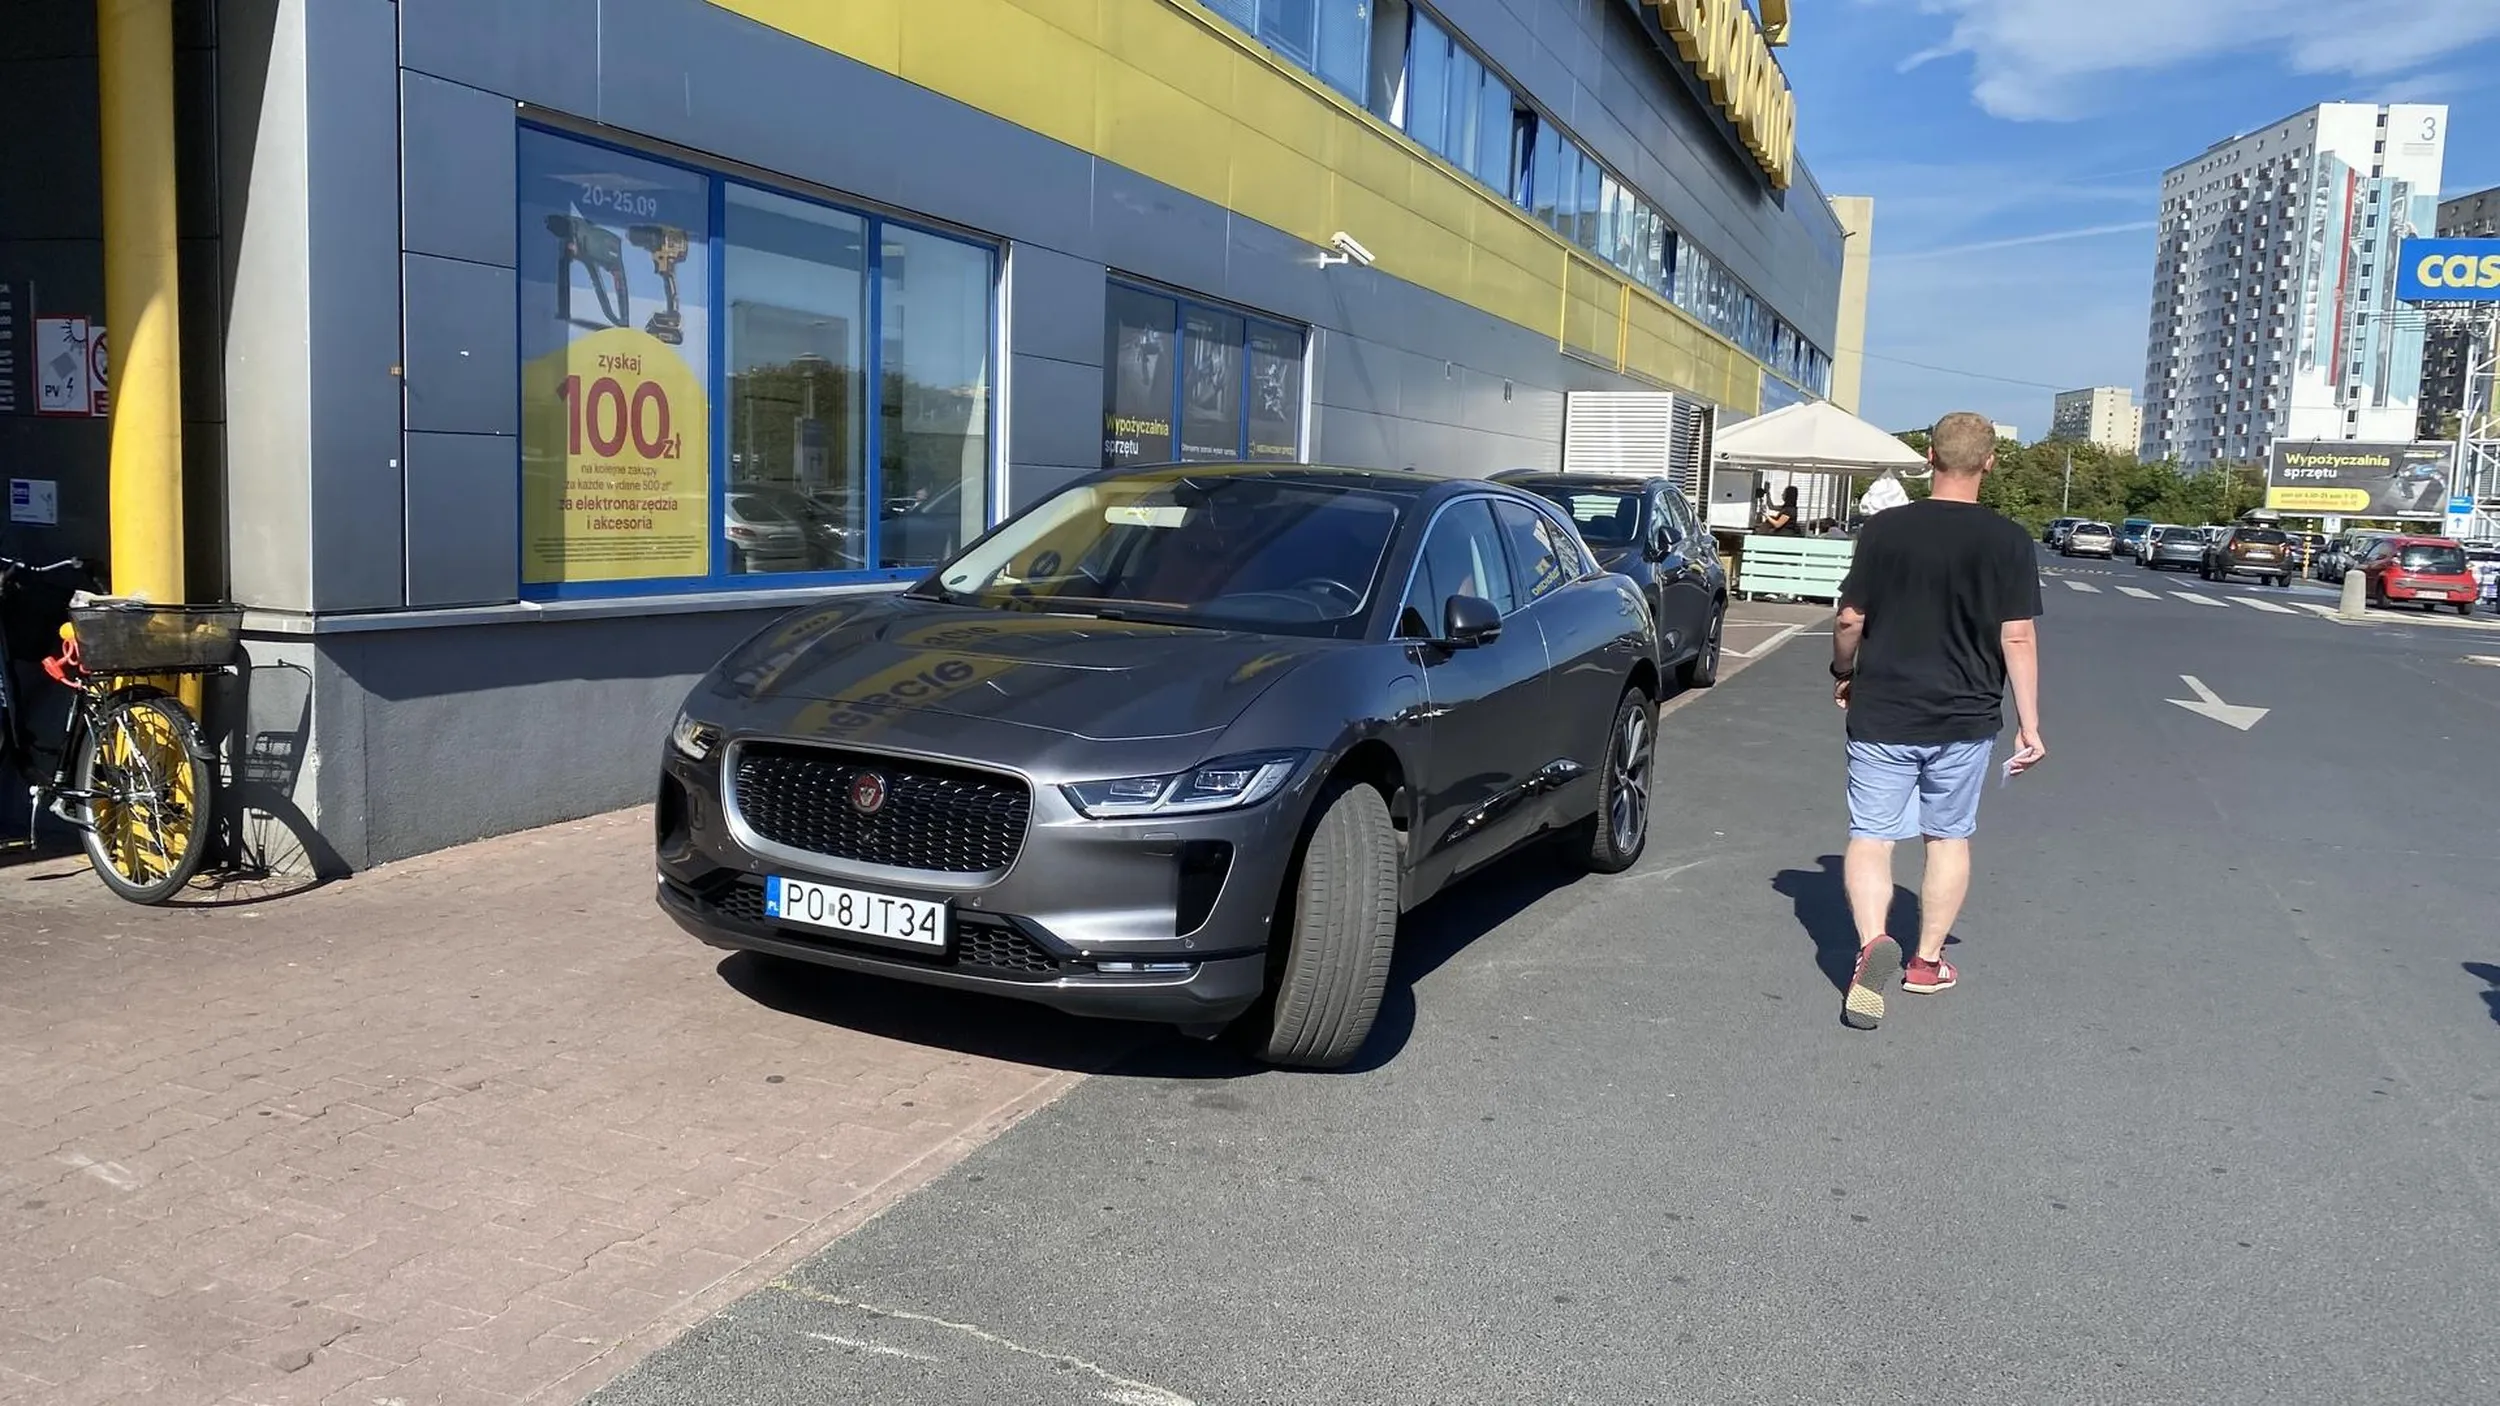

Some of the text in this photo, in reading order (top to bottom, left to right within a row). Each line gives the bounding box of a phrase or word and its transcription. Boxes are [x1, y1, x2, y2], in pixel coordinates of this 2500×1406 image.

[2421, 117, 2436, 141] 3
[581, 183, 657, 217] 20-25.09
[2417, 254, 2500, 289] cas
[598, 354, 642, 375] zyskaj
[45, 385, 59, 397] PV
[1105, 414, 1169, 436] Wypożyczalnia
[1104, 438, 1139, 458] sprzętu
[2284, 452, 2390, 469] Wypożyczalnia
[2283, 466, 2338, 482] sprzętu
[558, 496, 678, 514] za elektronarzędzia
[593, 515, 653, 530] akcesoria
[767, 900, 779, 912] PL
[787, 883, 936, 941] PO 8JT34
